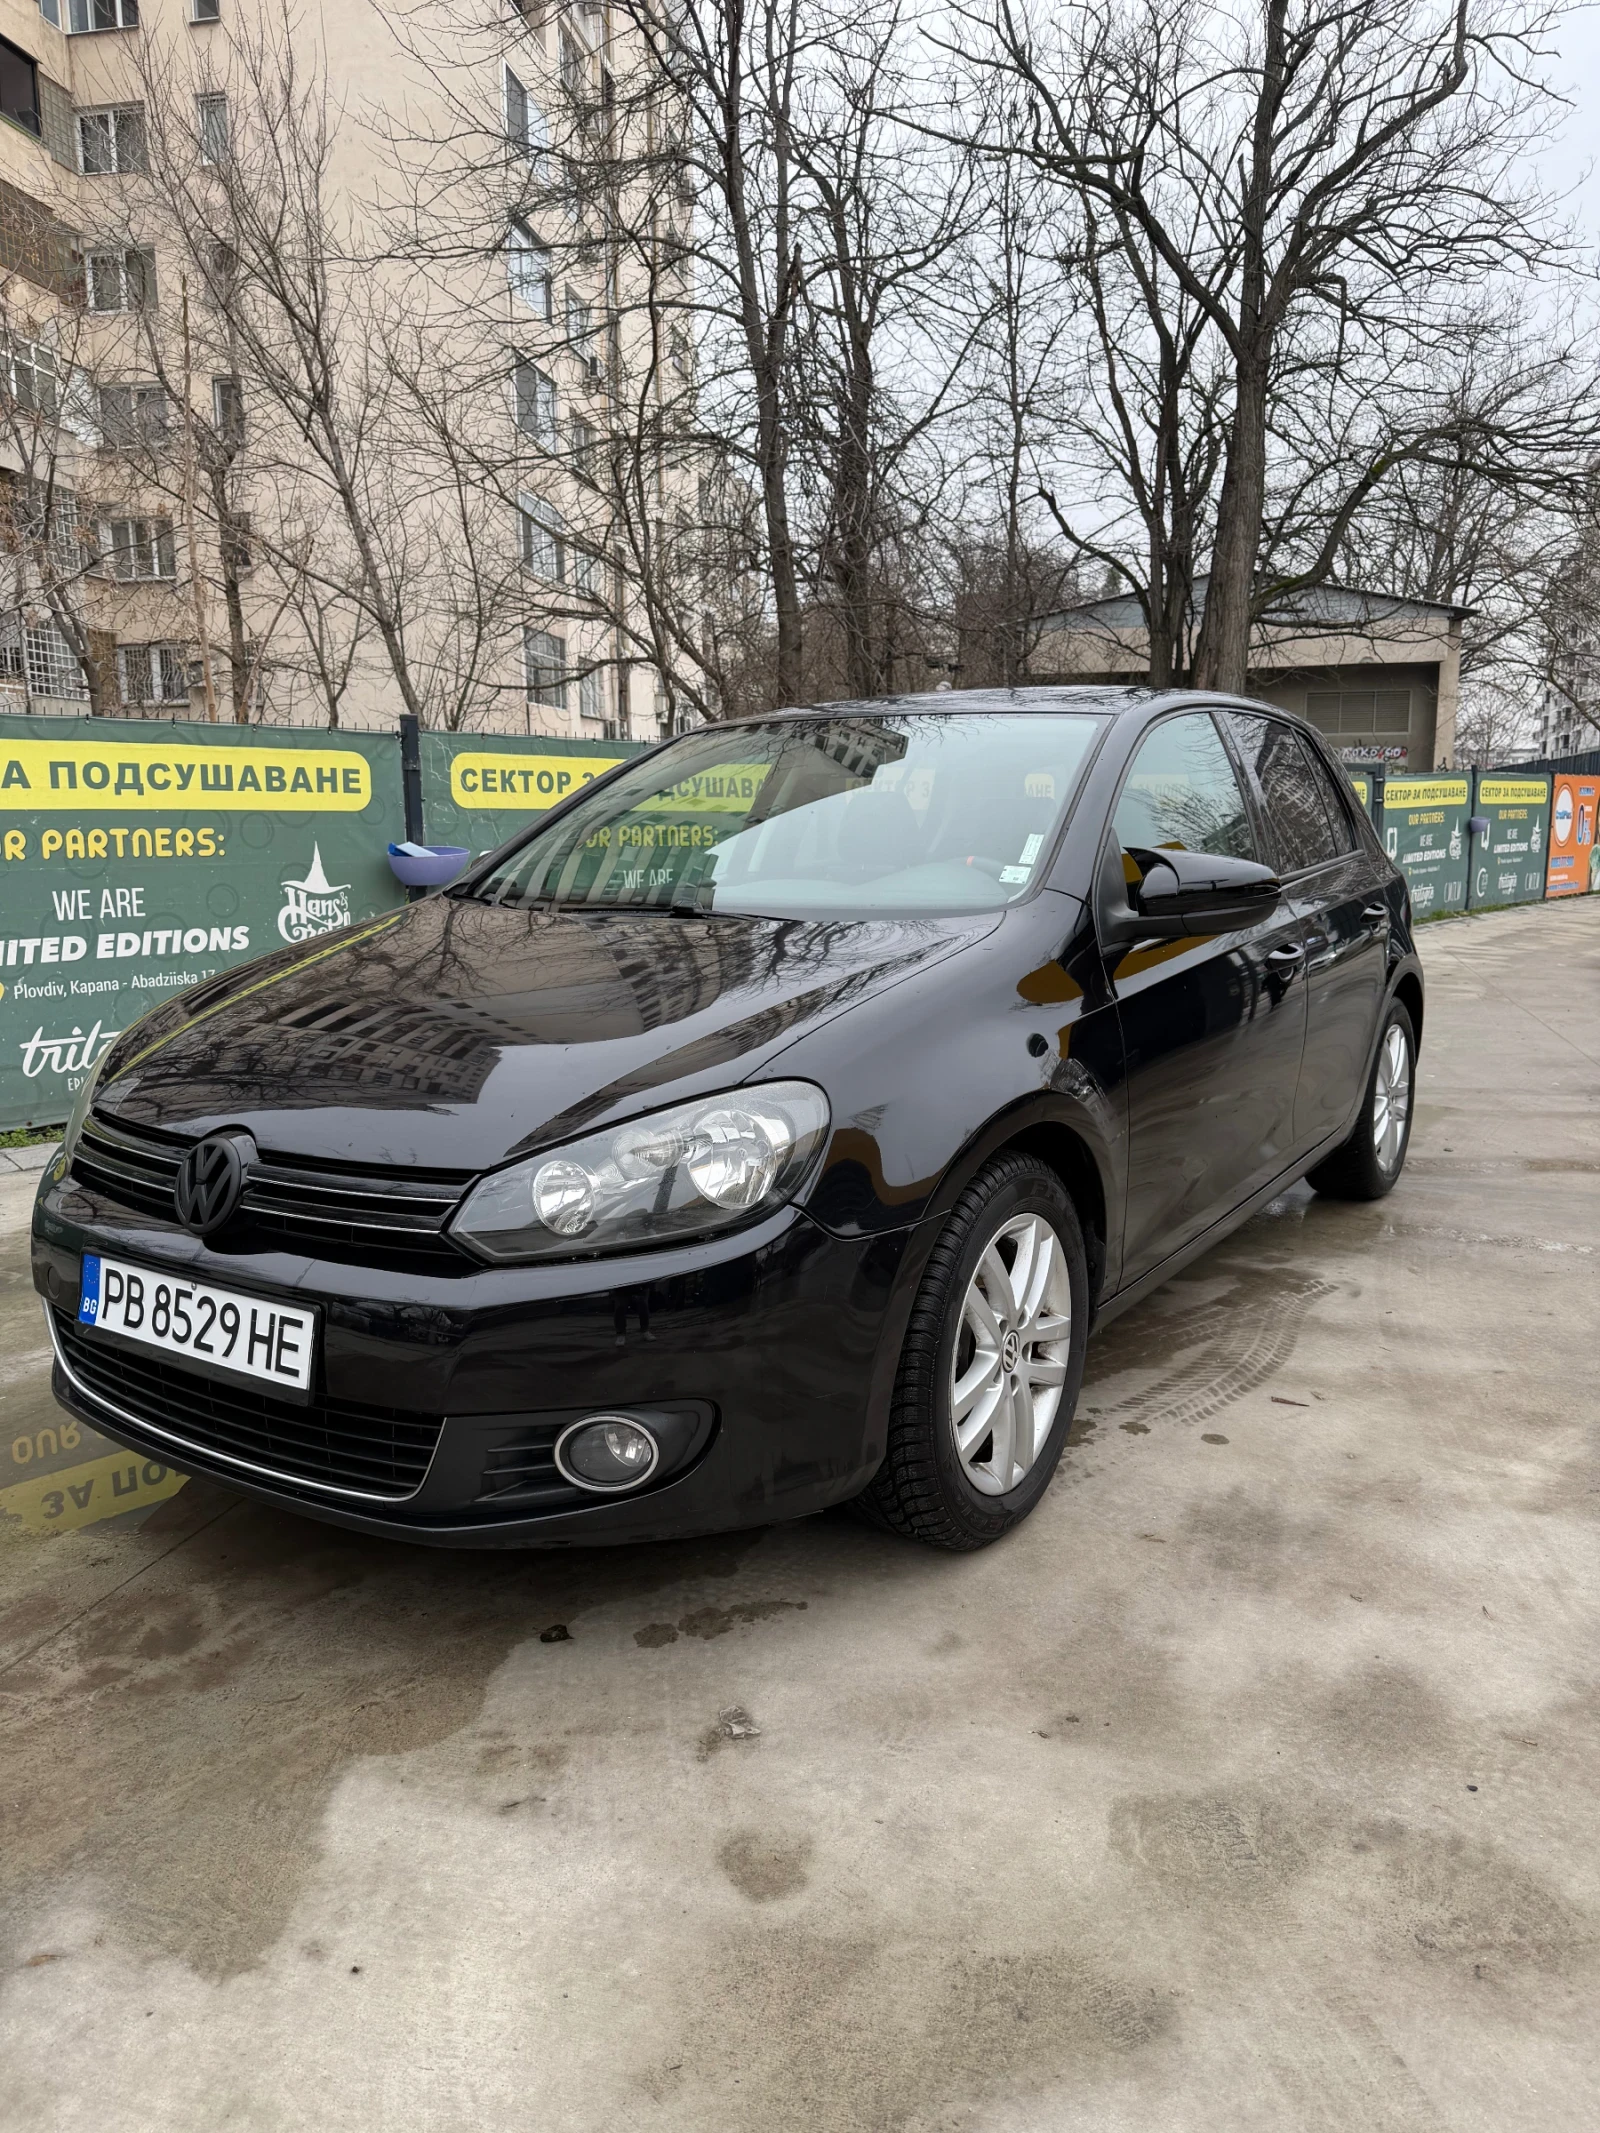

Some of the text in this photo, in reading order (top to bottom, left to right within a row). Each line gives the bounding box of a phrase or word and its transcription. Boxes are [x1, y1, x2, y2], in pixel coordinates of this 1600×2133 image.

[49, 760, 362, 796] ПОДСУШАВАНЕ
[460, 768, 571, 794] СЕКТОР
[1481, 787, 1501, 798] СЕКТОР
[1510, 787, 1547, 799] ПОДСУШАВАНЕ
[1386, 787, 1467, 801] СЕКТОР ЗА ПОДСУШАВАНЕ
[41, 827, 226, 861] PARTNERS:
[618, 823, 719, 848] PARTNERS:
[52, 887, 146, 921] WE ARE
[284, 886, 349, 927] Hans &
[0, 925, 250, 967] ITED EDITIONS
[13, 981, 68, 1000] Plovdiv,
[70, 979, 120, 996] Kapana
[131, 971, 199, 989] Abadziiska
[83, 1296, 97, 1315] BG
[102, 1267, 303, 1378] PB 8529 HE
